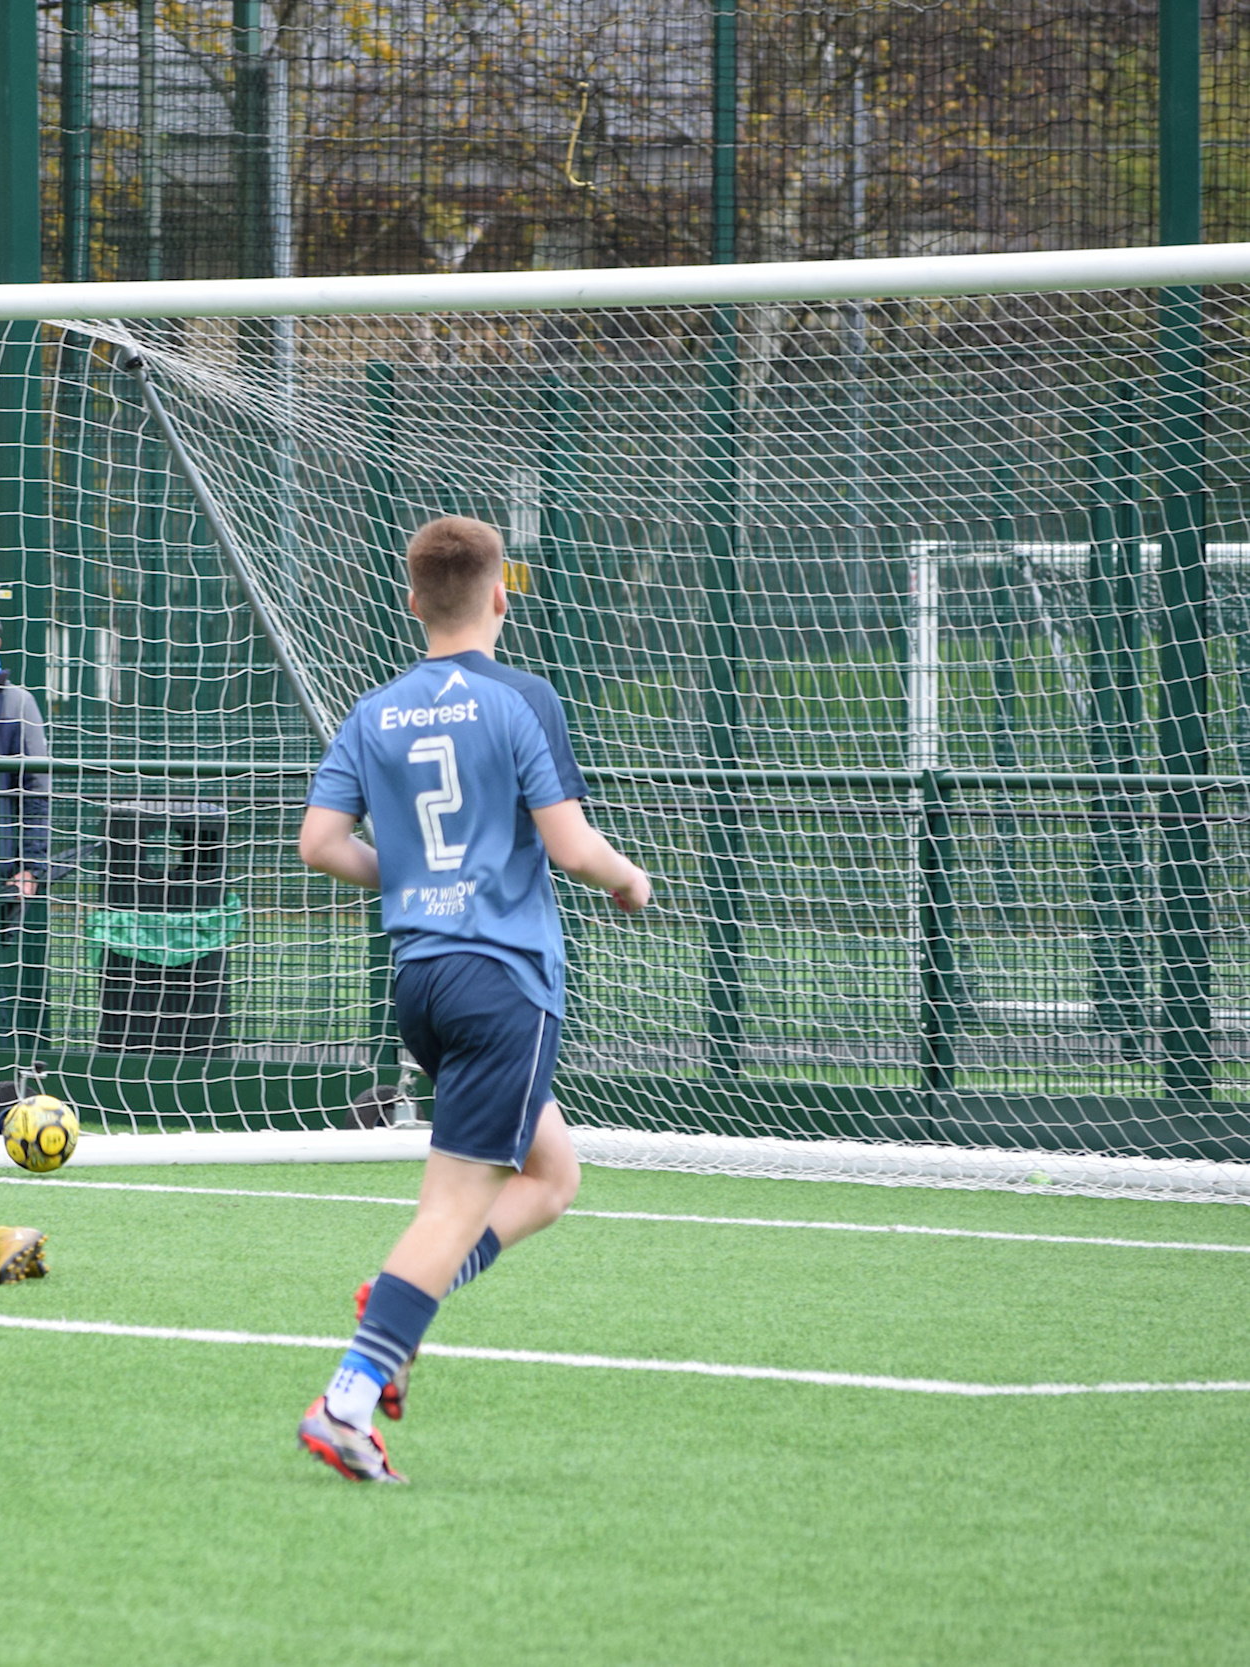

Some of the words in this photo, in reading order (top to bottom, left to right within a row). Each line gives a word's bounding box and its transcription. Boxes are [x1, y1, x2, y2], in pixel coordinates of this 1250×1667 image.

[380, 699, 478, 730] Everest
[407, 735, 468, 872] 2
[421, 886, 439, 903] W2
